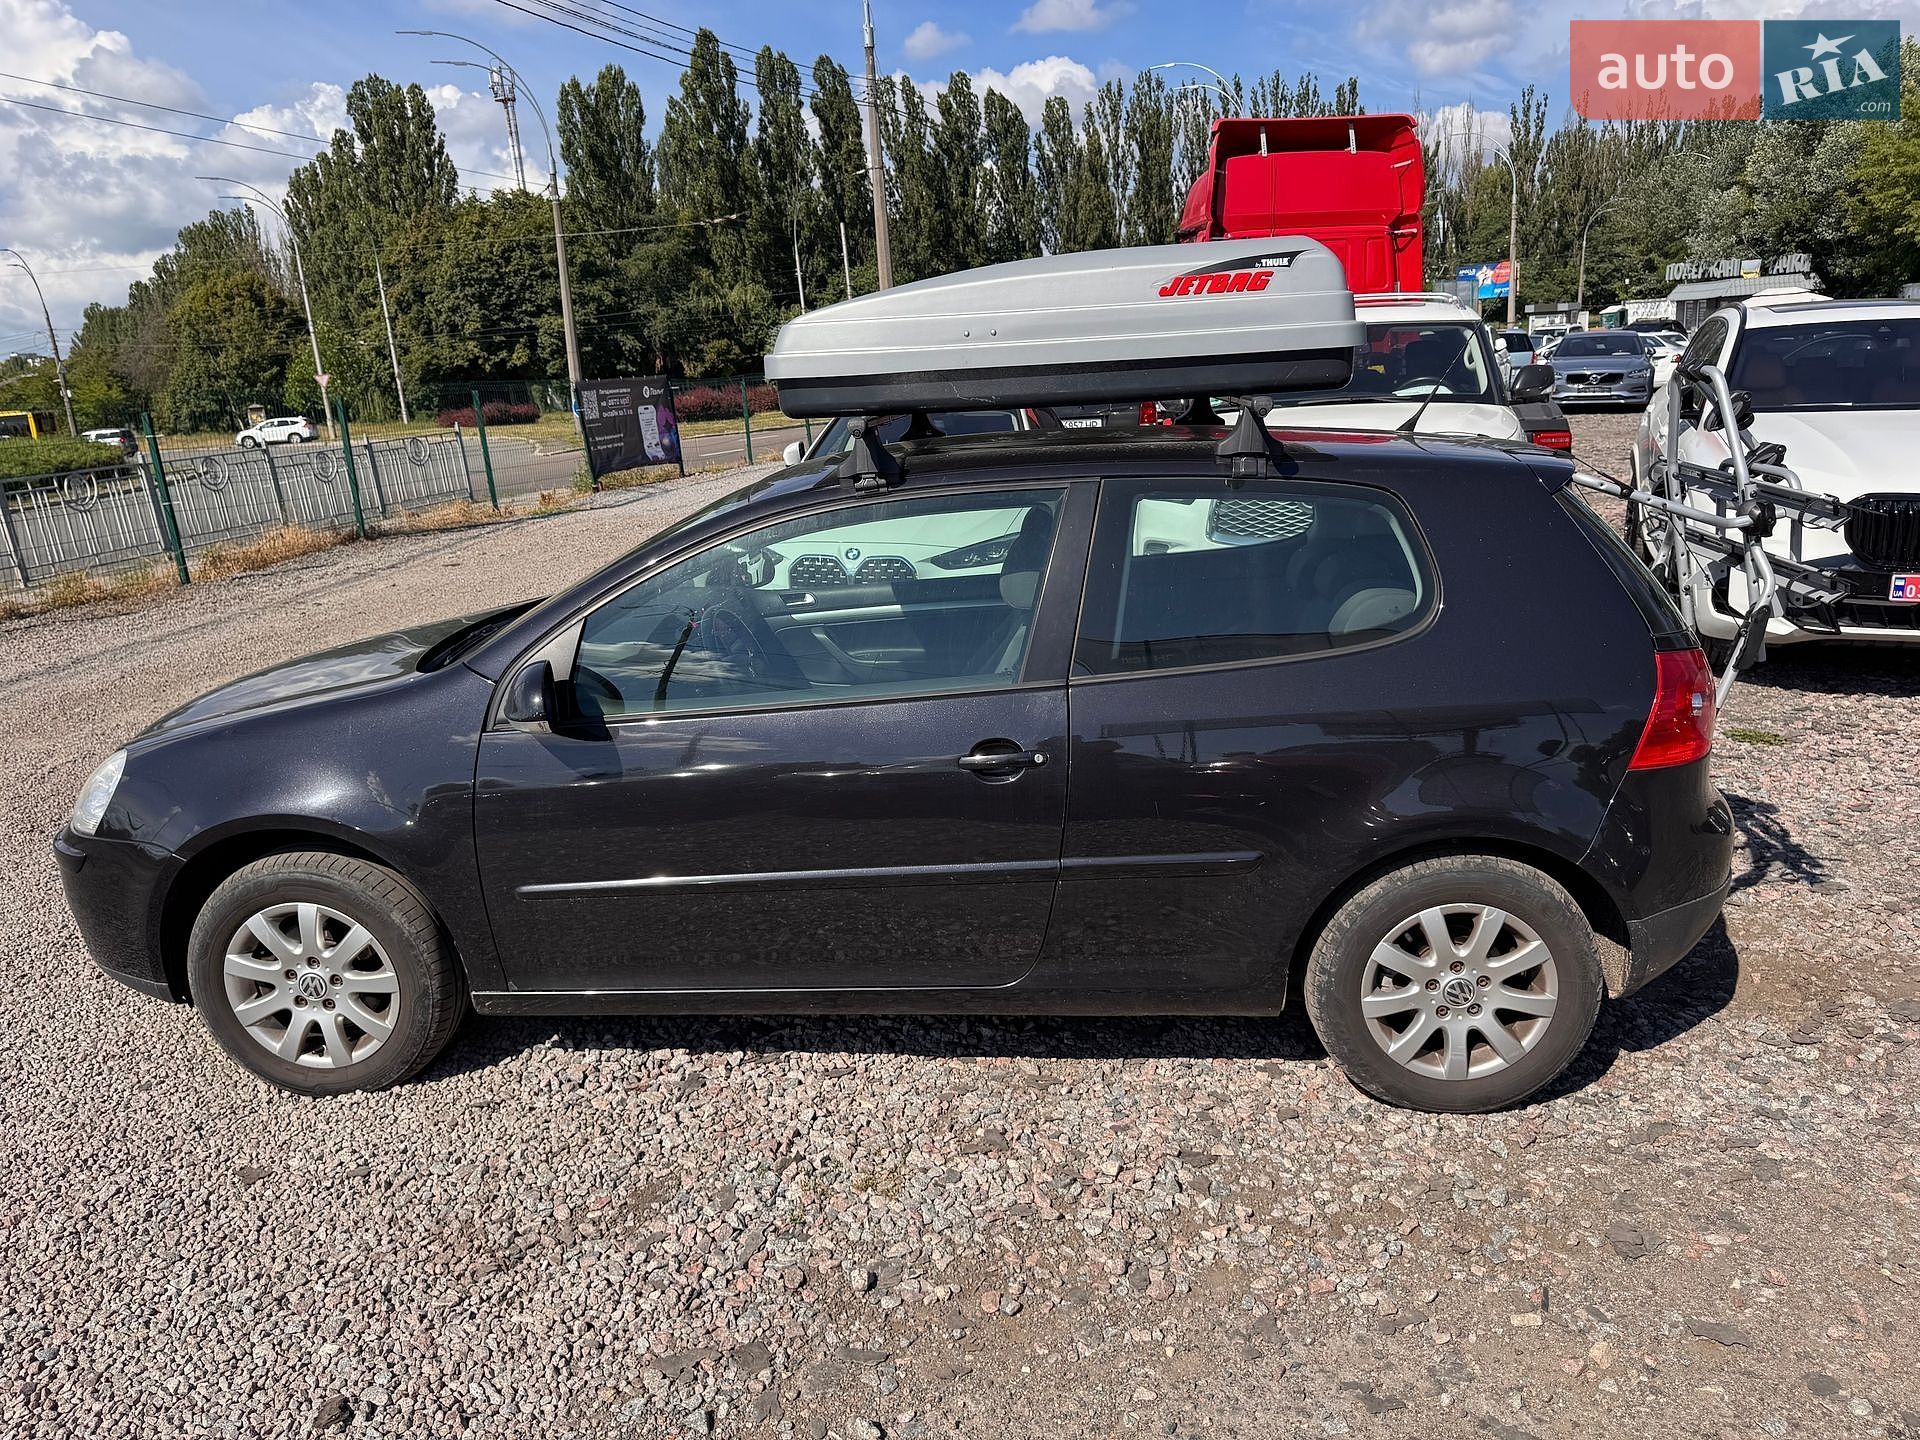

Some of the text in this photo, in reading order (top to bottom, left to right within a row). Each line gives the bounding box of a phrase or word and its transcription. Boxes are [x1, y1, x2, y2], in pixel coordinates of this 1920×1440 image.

[1261, 257, 1289, 267] THULE
[1158, 270, 1275, 298] JETBAG
[1893, 590, 1903, 598] UA
